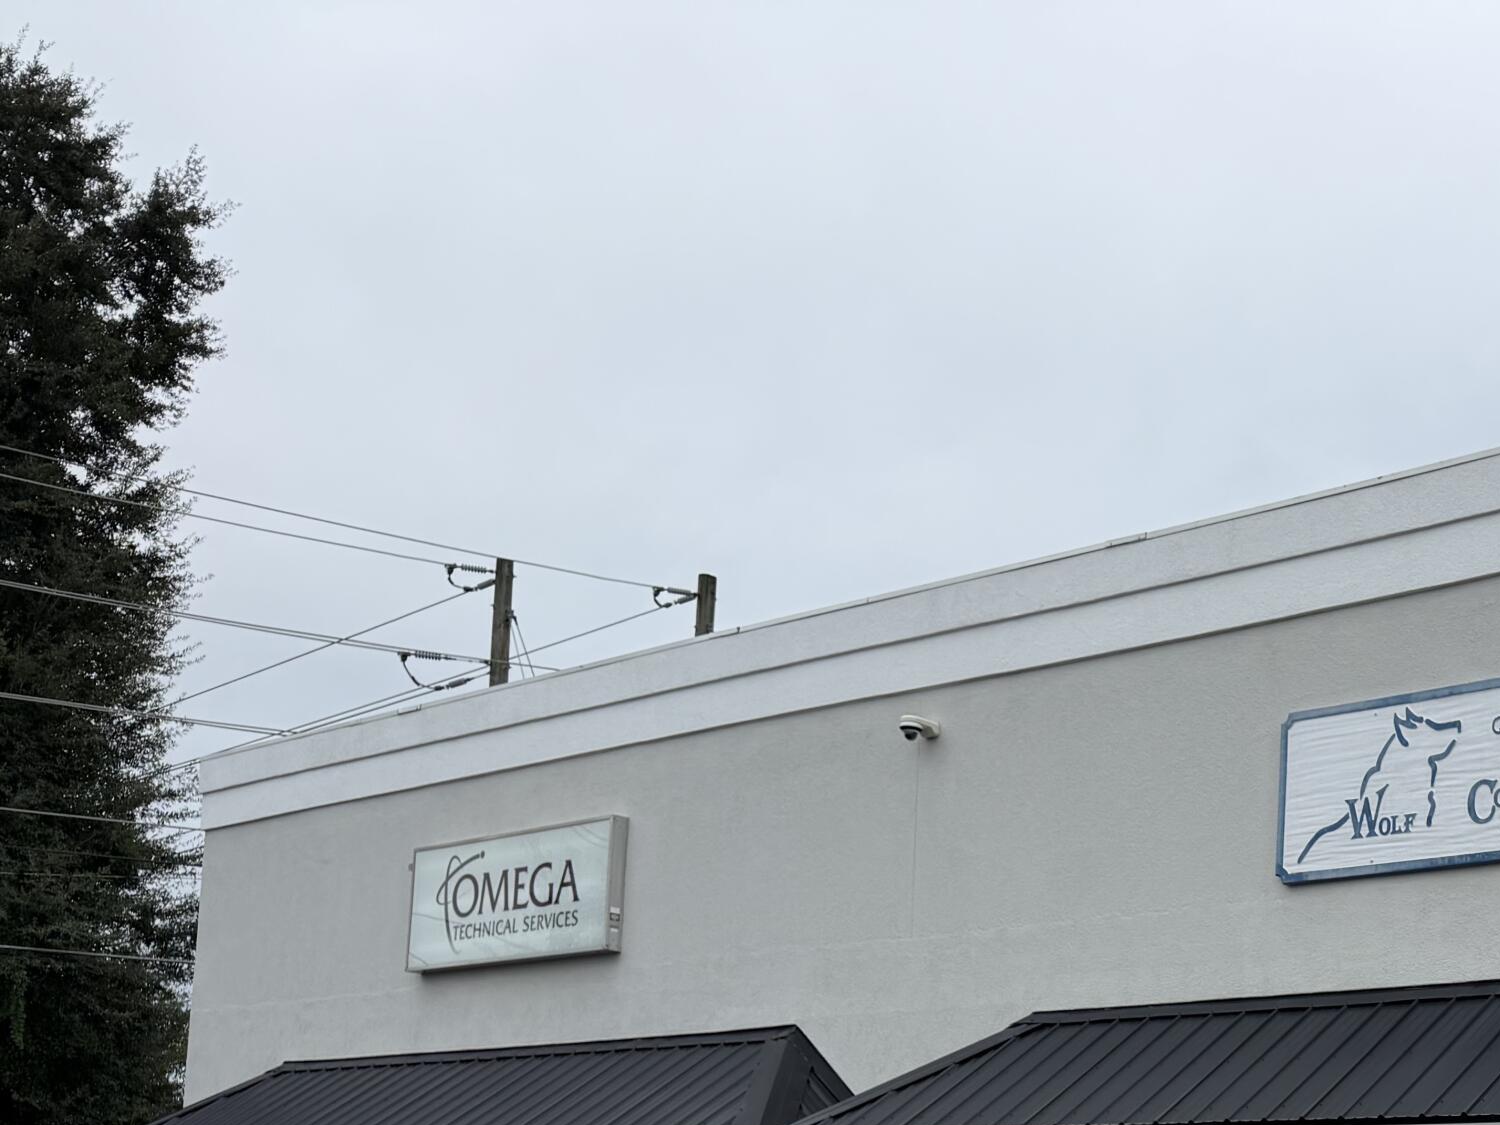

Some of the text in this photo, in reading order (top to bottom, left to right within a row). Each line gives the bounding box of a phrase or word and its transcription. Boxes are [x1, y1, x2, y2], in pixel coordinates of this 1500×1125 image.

[451, 858, 581, 919] OMEGA
[452, 909, 580, 942] TECHNICAL SERVICES
